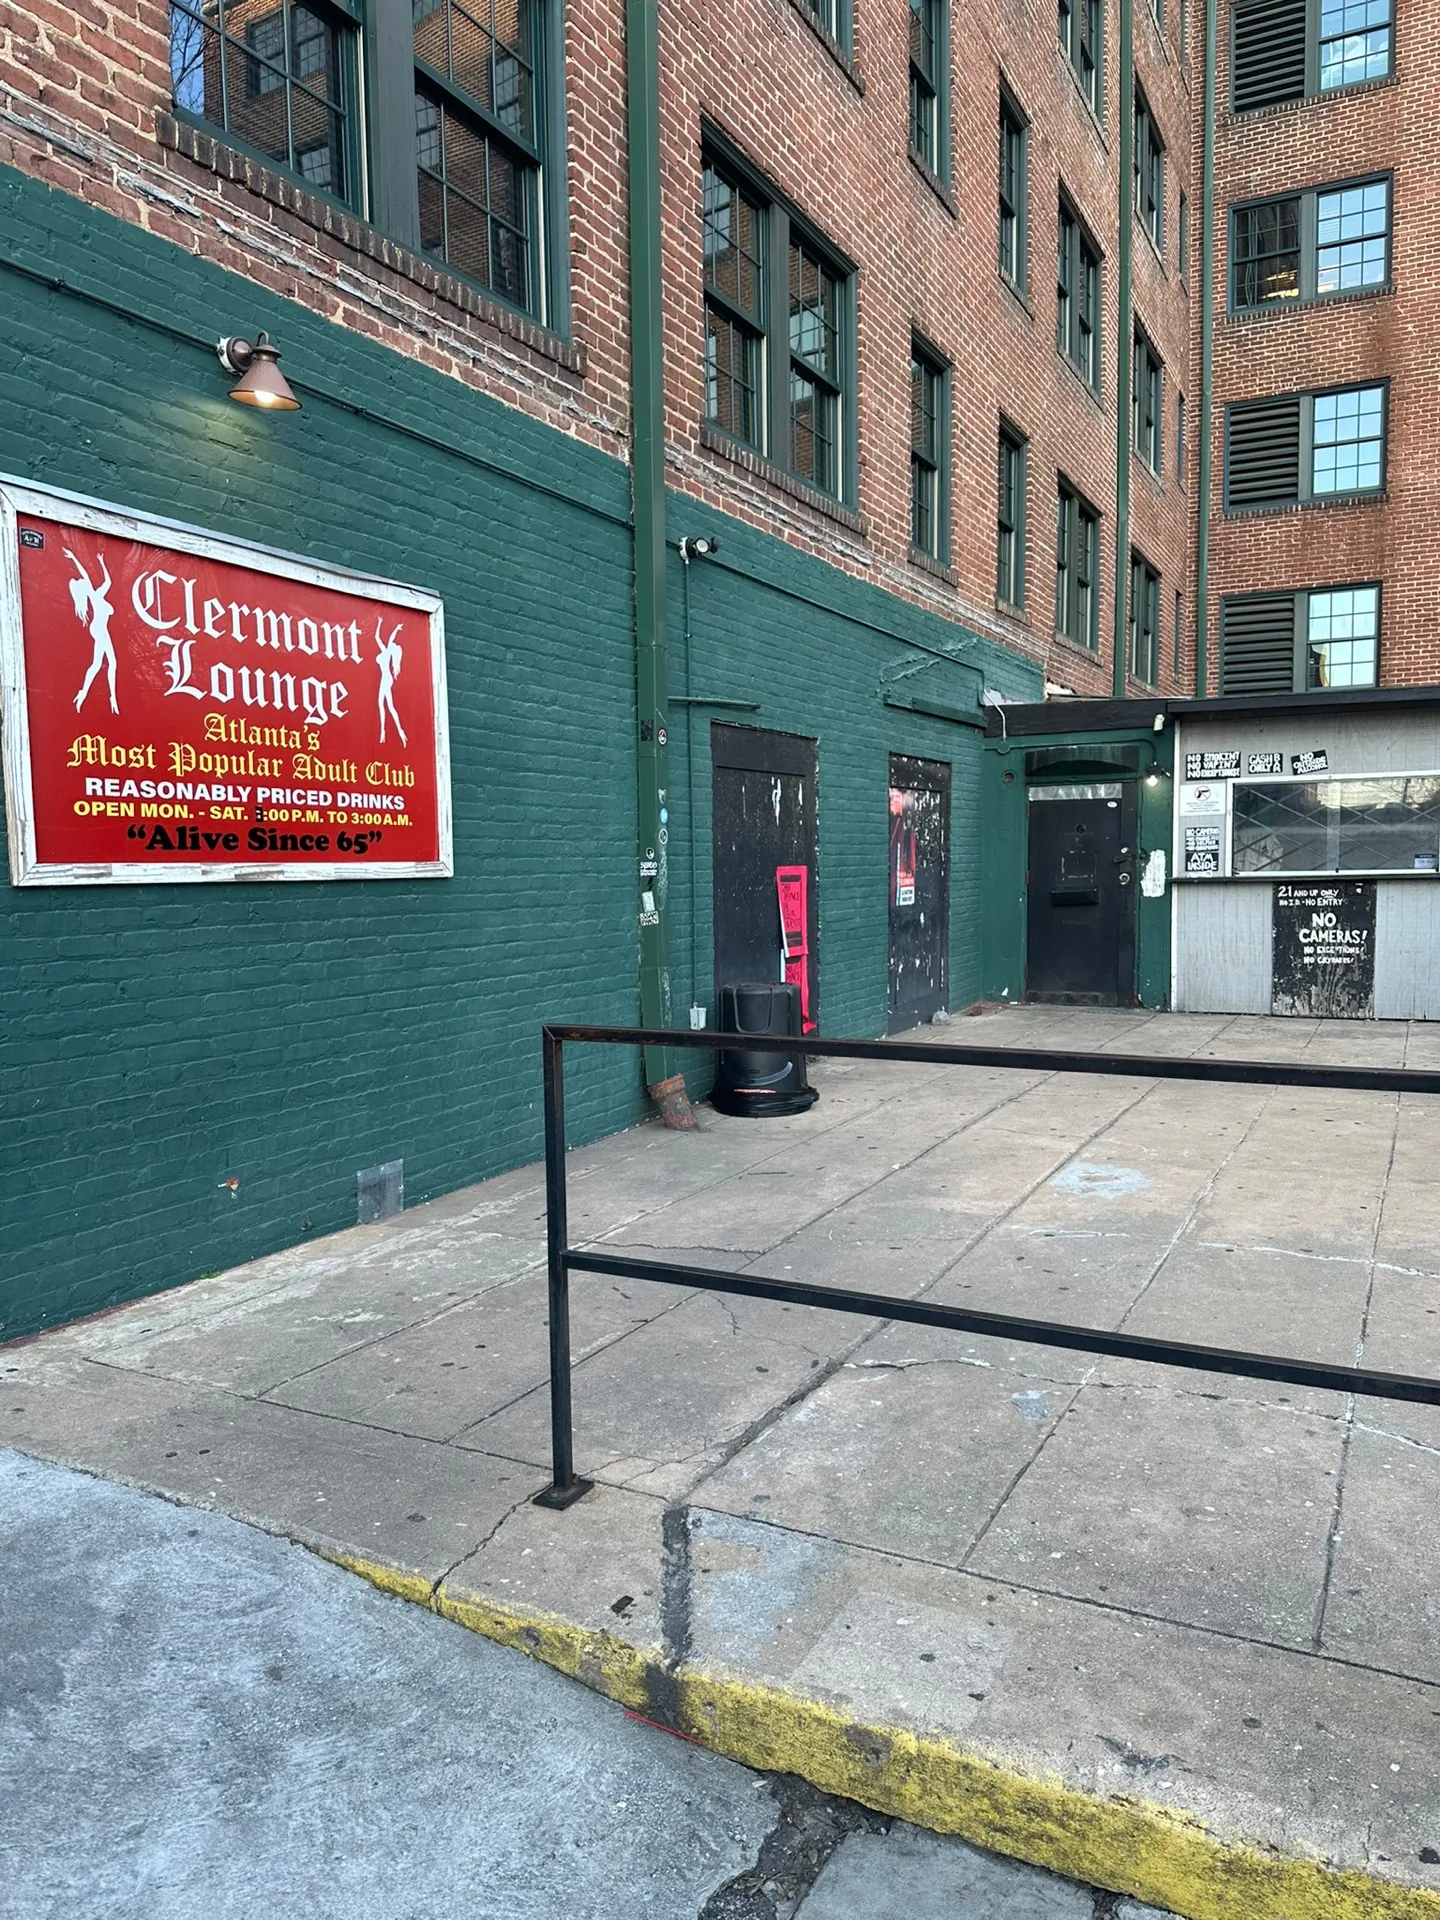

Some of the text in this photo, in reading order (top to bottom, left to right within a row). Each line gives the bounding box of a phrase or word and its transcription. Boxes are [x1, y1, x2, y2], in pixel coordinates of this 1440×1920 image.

[131, 570, 364, 664] Clermont
[156, 638, 349, 726] Lounge
[203, 713, 320, 751] Atlanta's
[66, 734, 415, 787] Most Popular Adult Club
[1187, 754, 1201, 762] NO
[1249, 754, 1273, 764] CASH
[1300, 752, 1314, 761] NO
[1187, 762, 1201, 770] NO
[1293, 756, 1326, 769] OUTSIDE
[1187, 769, 1201, 778] NO
[1249, 764, 1272, 773] ONLY
[85, 777, 405, 810] REASONABLY PRICED DRINKS
[73, 801, 135, 817] OPEN
[140, 803, 194, 819] MON.
[210, 806, 248, 821] SAT.
[291, 809, 324, 823] P.M.
[328, 810, 347, 824] TO
[351, 811, 381, 825] 3:00
[382, 812, 412, 826] A.M.
[248, 826, 329, 852] Since
[1190, 852, 1213, 863] ATM
[1187, 861, 1217, 871] INSIDE
[1278, 885, 1339, 897] 21 AND UP ONLY
[1317, 897, 1343, 906] ENTRY
[1311, 912, 1337, 927] NO
[1298, 928, 1368, 944] CAMERAS!
[1303, 945, 1364, 954] NO EXCEPTIONS!
[1303, 956, 1315, 964] NO
